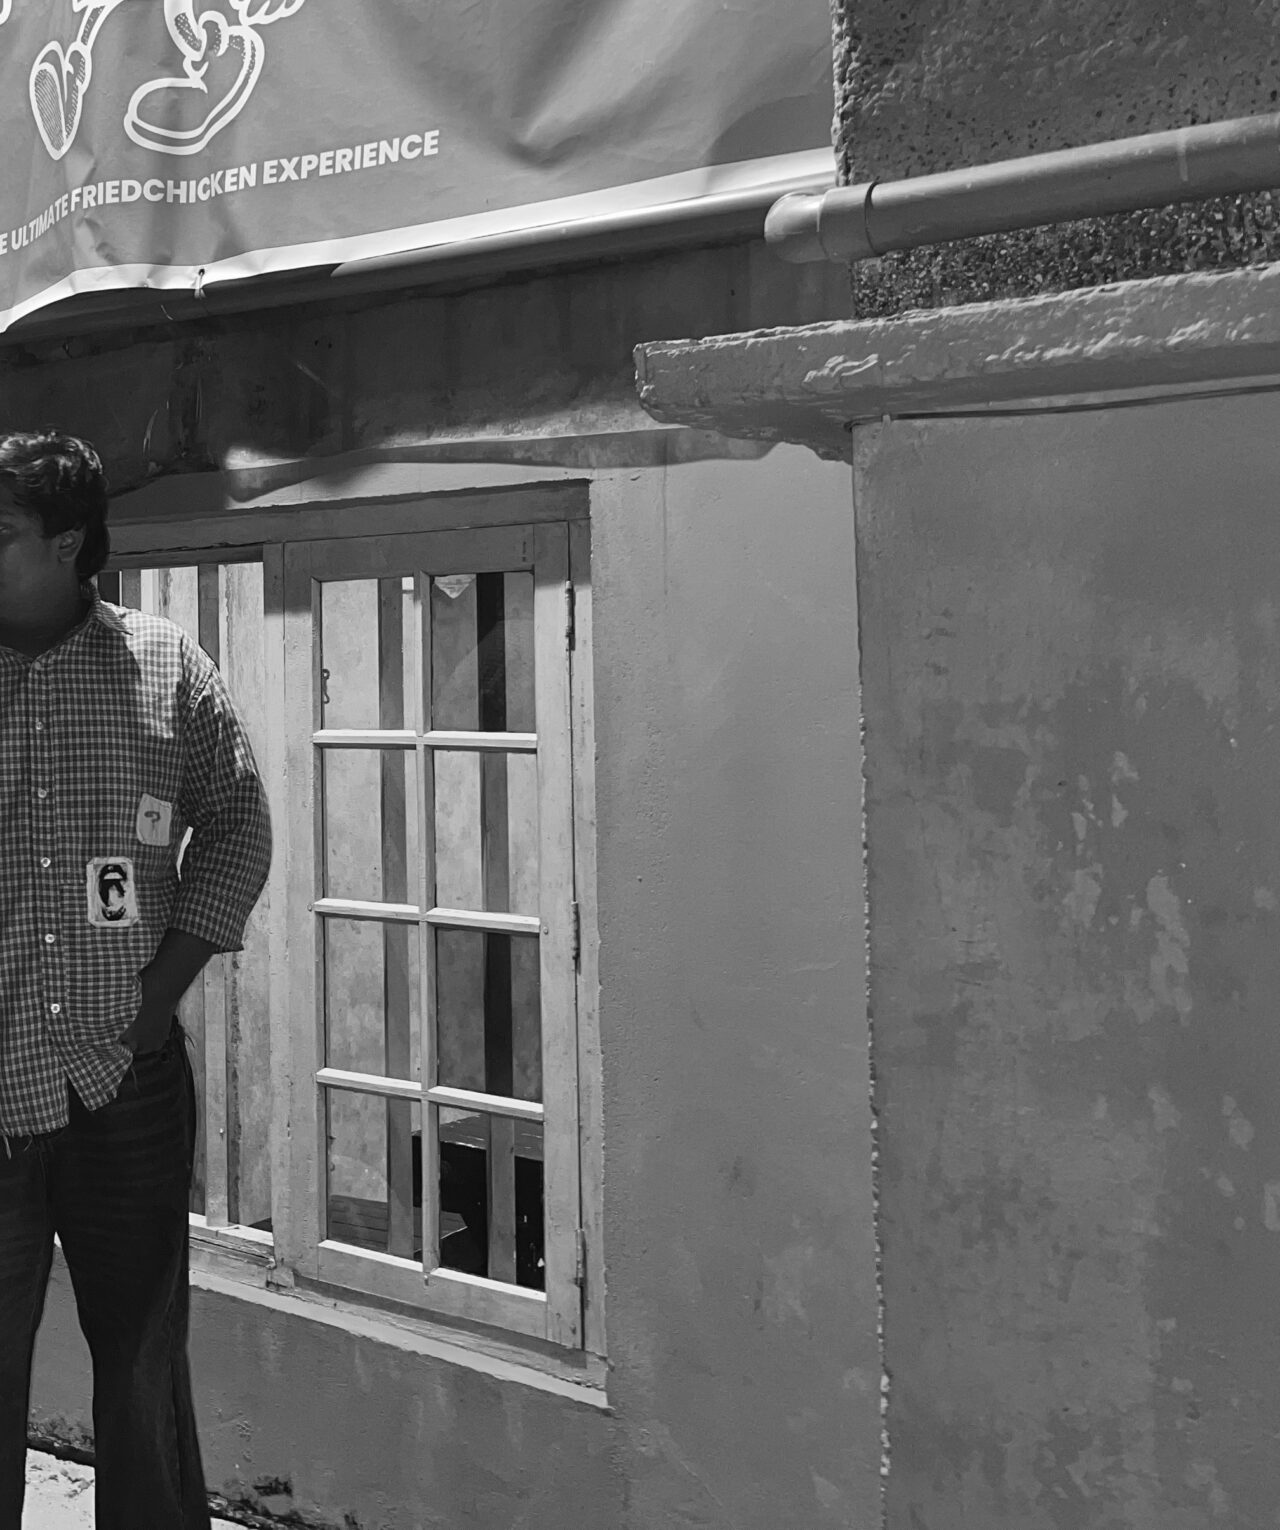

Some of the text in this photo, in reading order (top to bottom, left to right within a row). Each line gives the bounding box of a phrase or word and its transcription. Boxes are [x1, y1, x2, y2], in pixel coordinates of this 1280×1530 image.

[11, 193, 69, 250] ULTIMATE
[71, 165, 257, 212] FRIEDCHICKEN
[262, 129, 440, 185] EXPERIENCE
